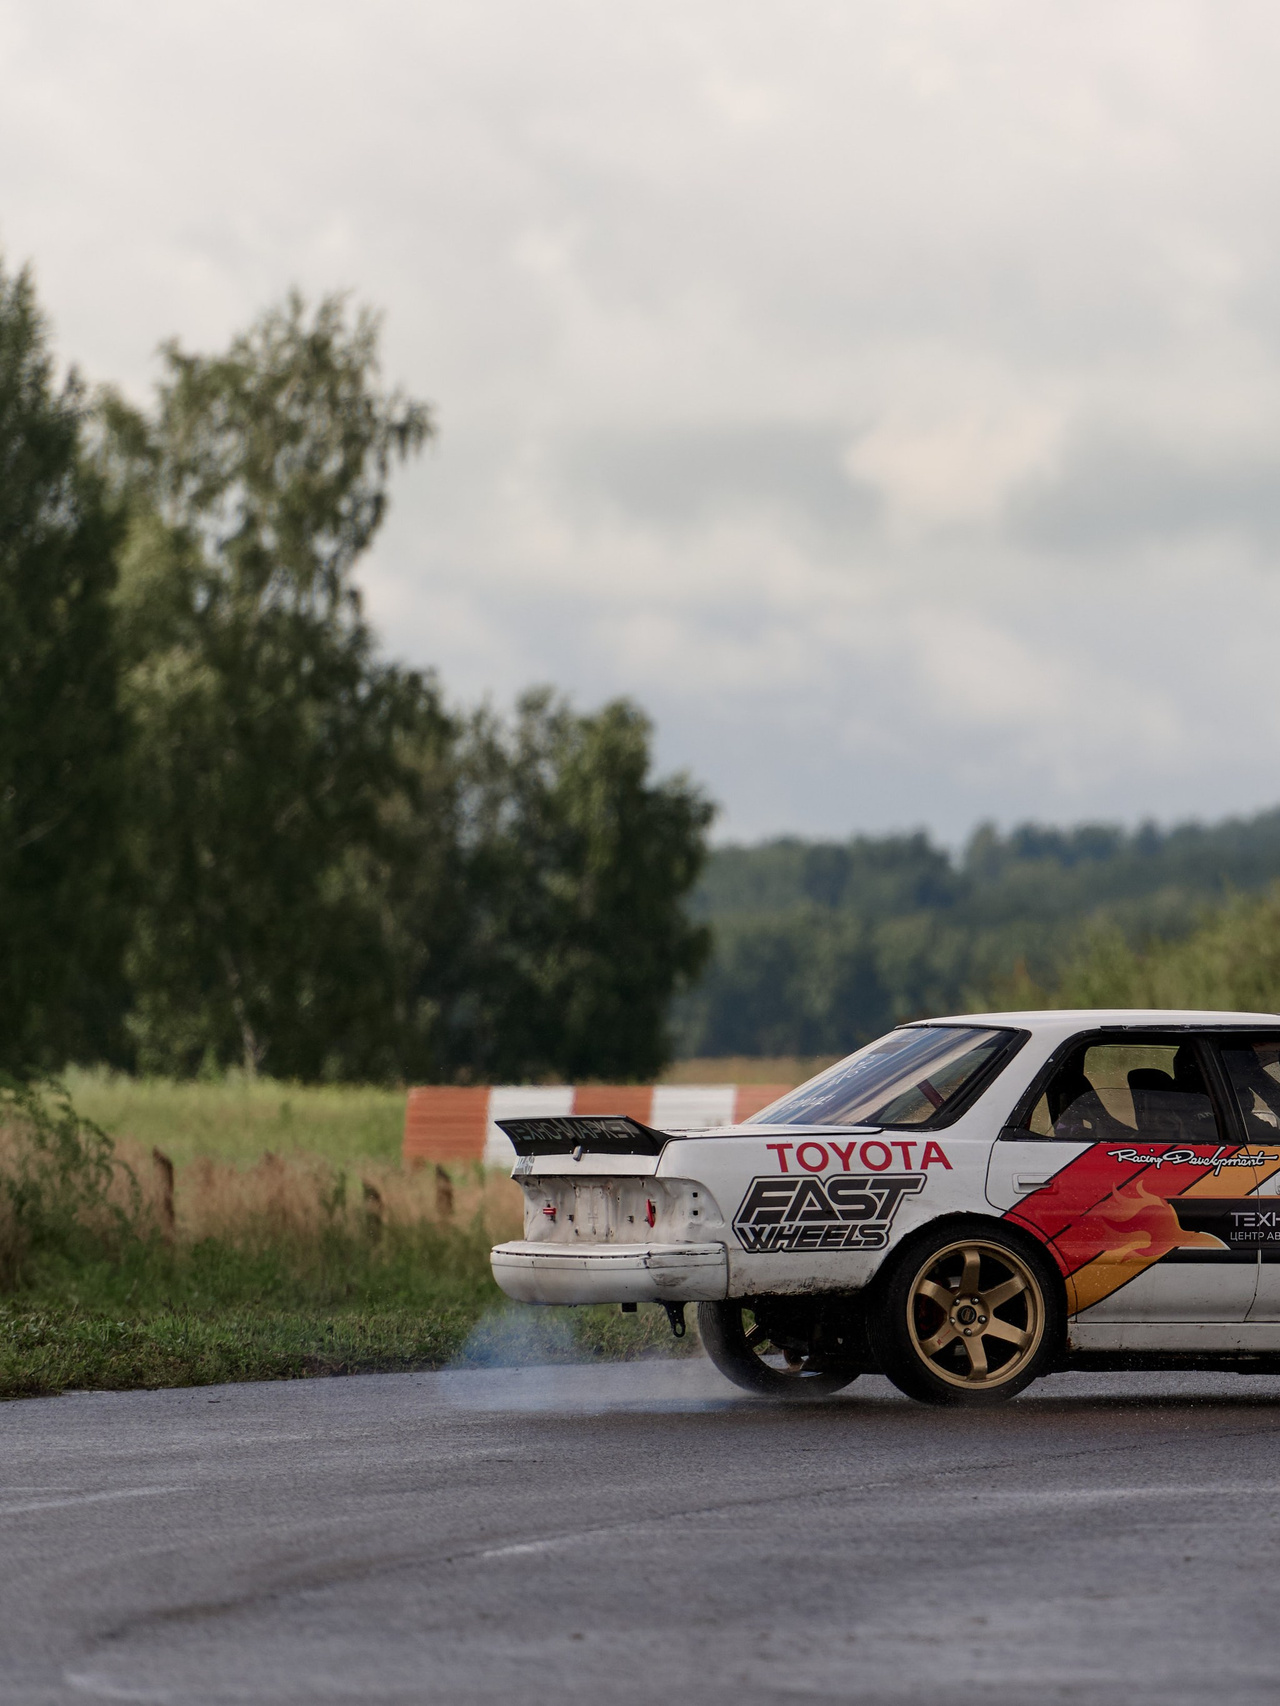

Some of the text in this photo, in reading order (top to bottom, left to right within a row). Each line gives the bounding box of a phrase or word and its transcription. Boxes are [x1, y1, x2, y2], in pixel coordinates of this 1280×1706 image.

[766, 1141, 953, 1172] TOYOTA
[1107, 1146, 1278, 1176] Racing Development
[738, 1177, 922, 1224] FAST
[737, 1223, 888, 1250] WHEELS
[1230, 1231, 1264, 1241] ЦЕНТР
